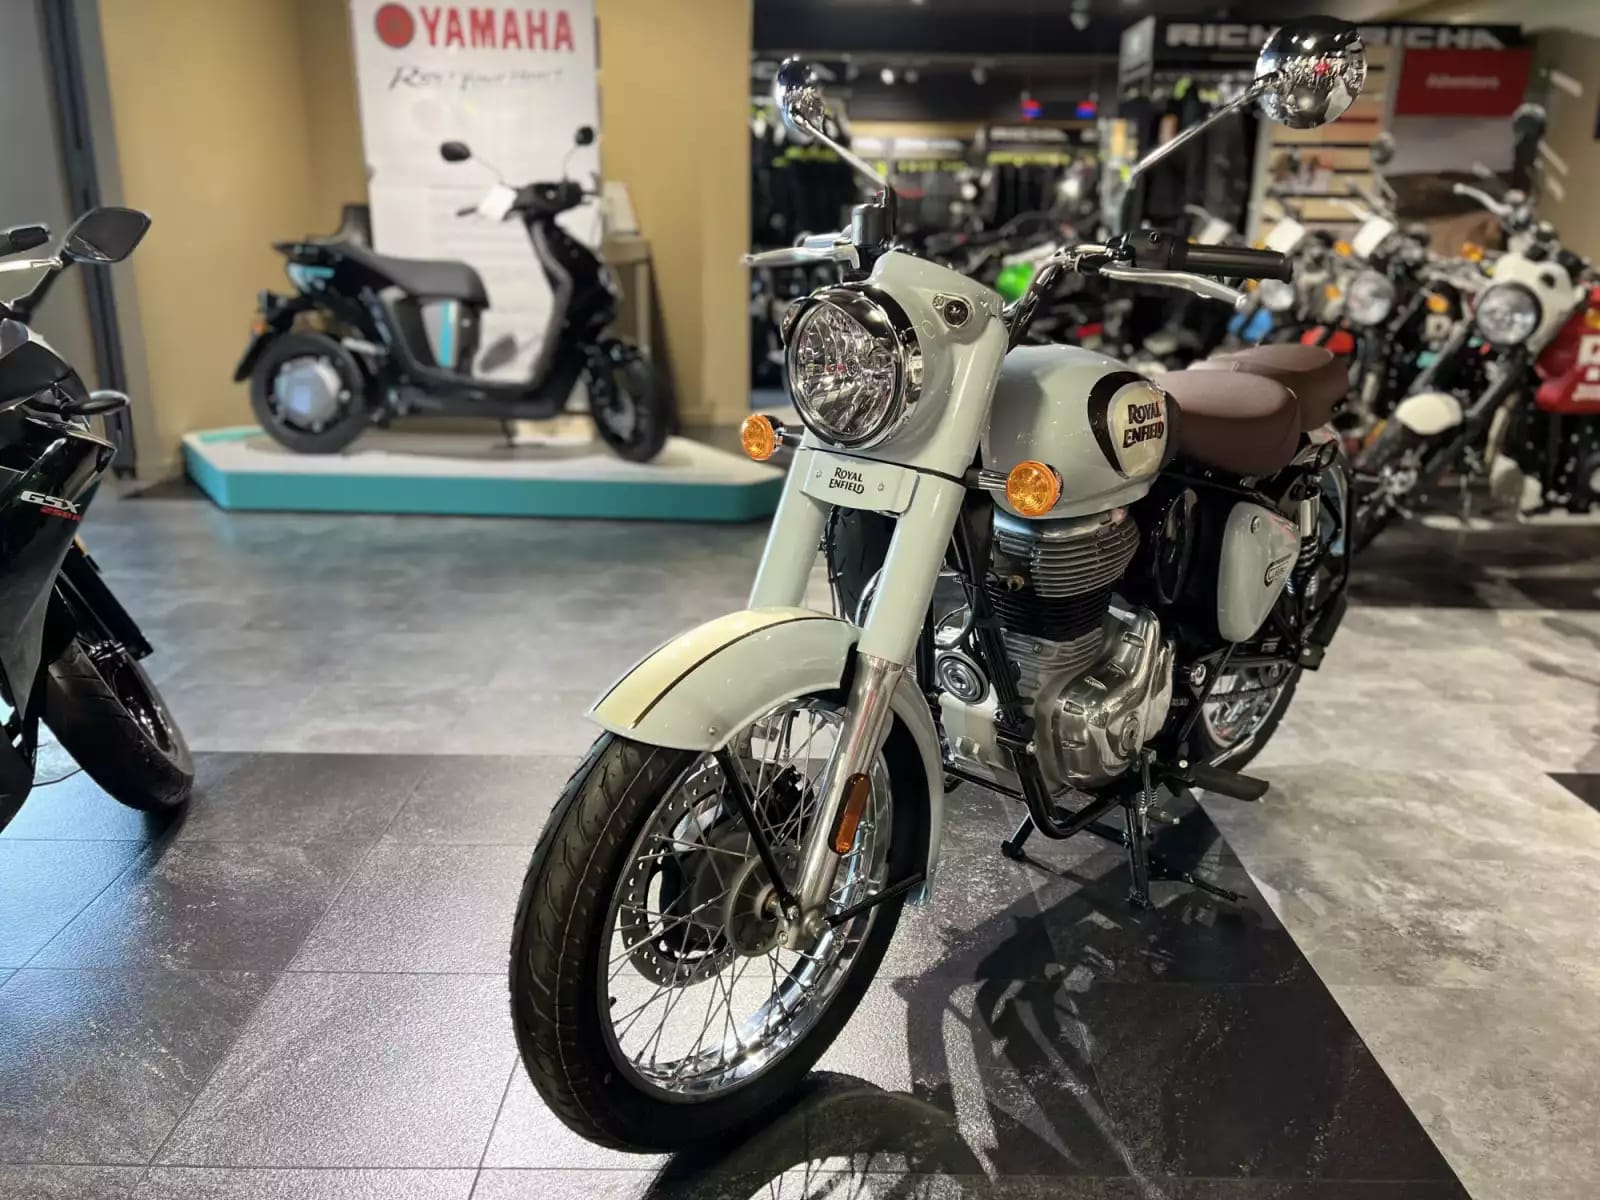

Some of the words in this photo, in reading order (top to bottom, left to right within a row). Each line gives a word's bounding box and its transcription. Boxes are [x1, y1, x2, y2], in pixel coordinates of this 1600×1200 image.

[420, 6, 576, 52] YAMAHA
[1127, 400, 1162, 425] ROYAL
[1122, 420, 1165, 449] ENFIELD
[828, 478, 865, 495] ENFIELD
[834, 467, 863, 482] ROYAL
[20, 490, 81, 514] GSX
